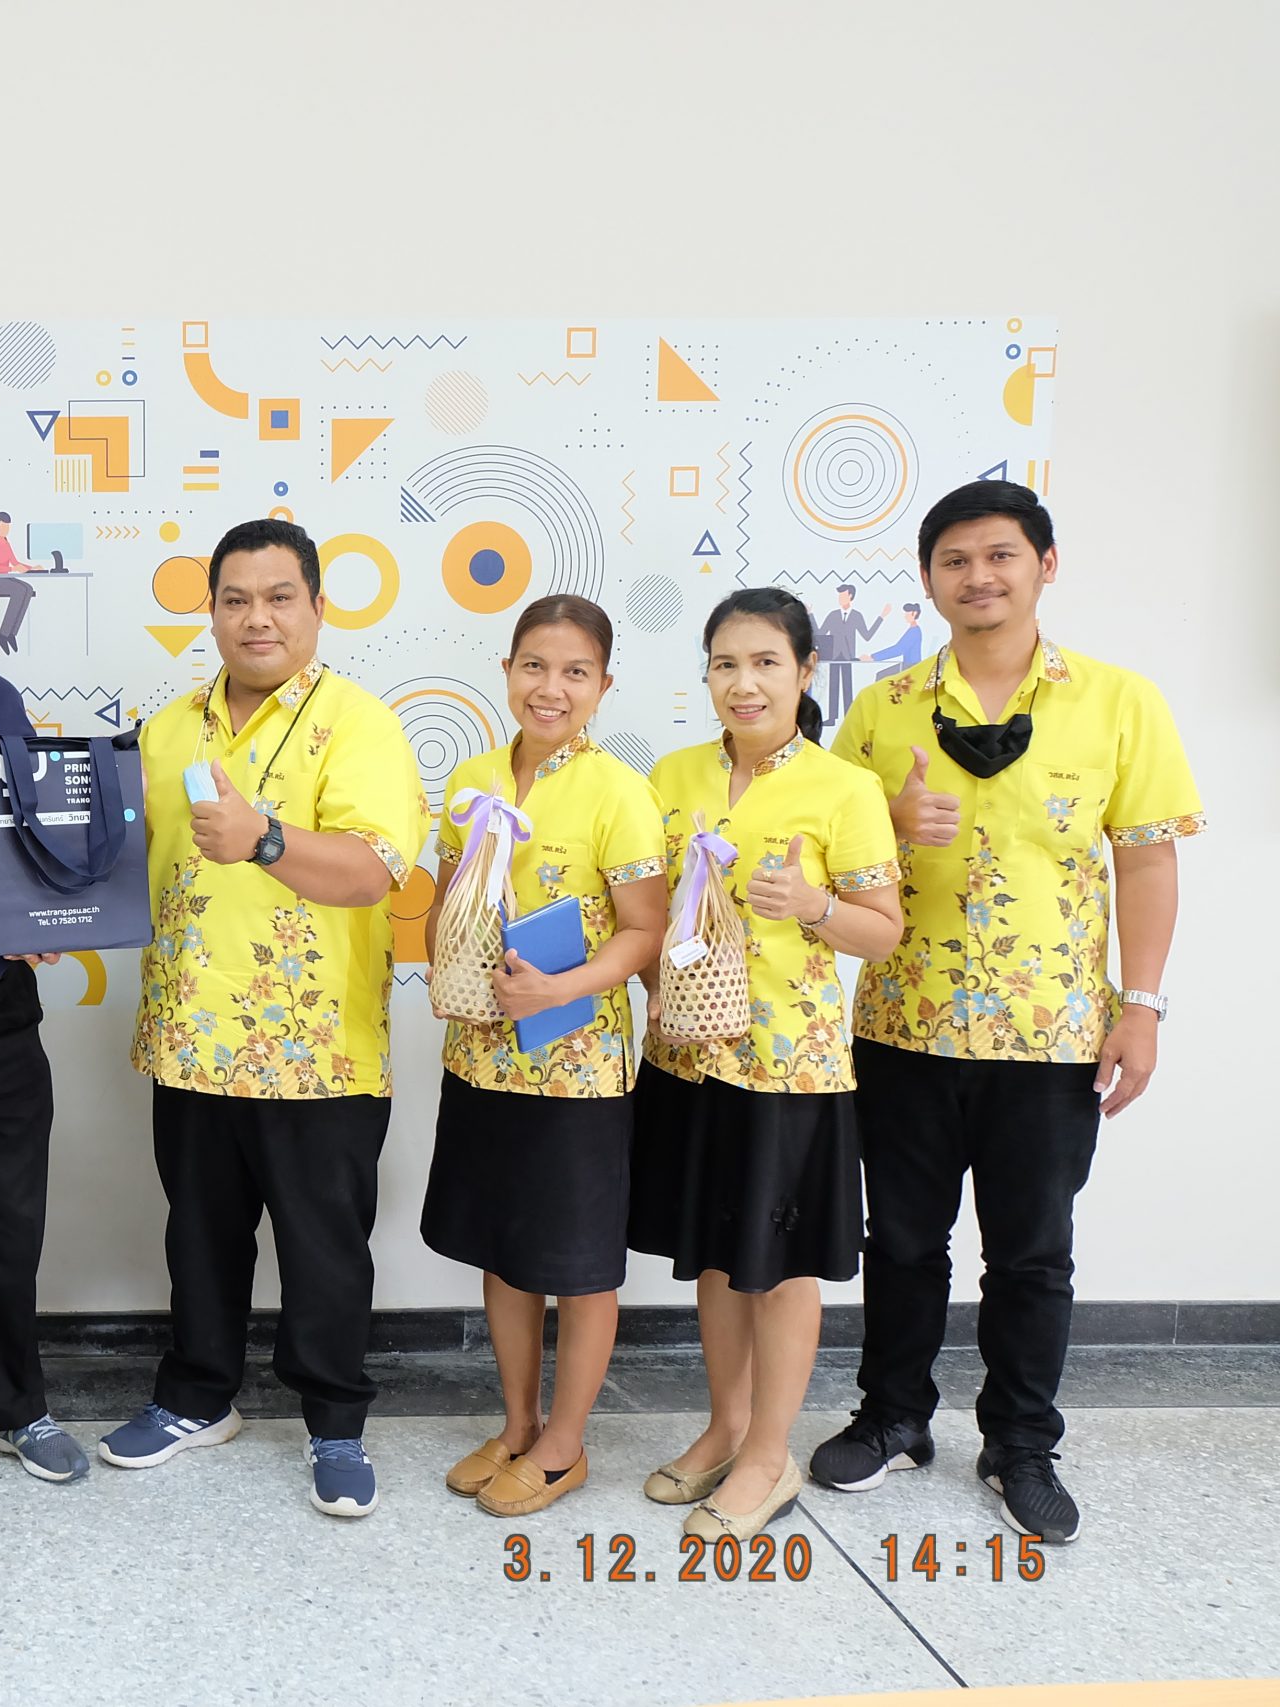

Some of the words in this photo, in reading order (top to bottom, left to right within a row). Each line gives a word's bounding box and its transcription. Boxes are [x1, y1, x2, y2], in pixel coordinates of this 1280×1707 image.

[28, 906, 100, 918] www.trang.psu.ac.th
[59, 916, 77, 925] 7520
[77, 915, 93, 924] 1712
